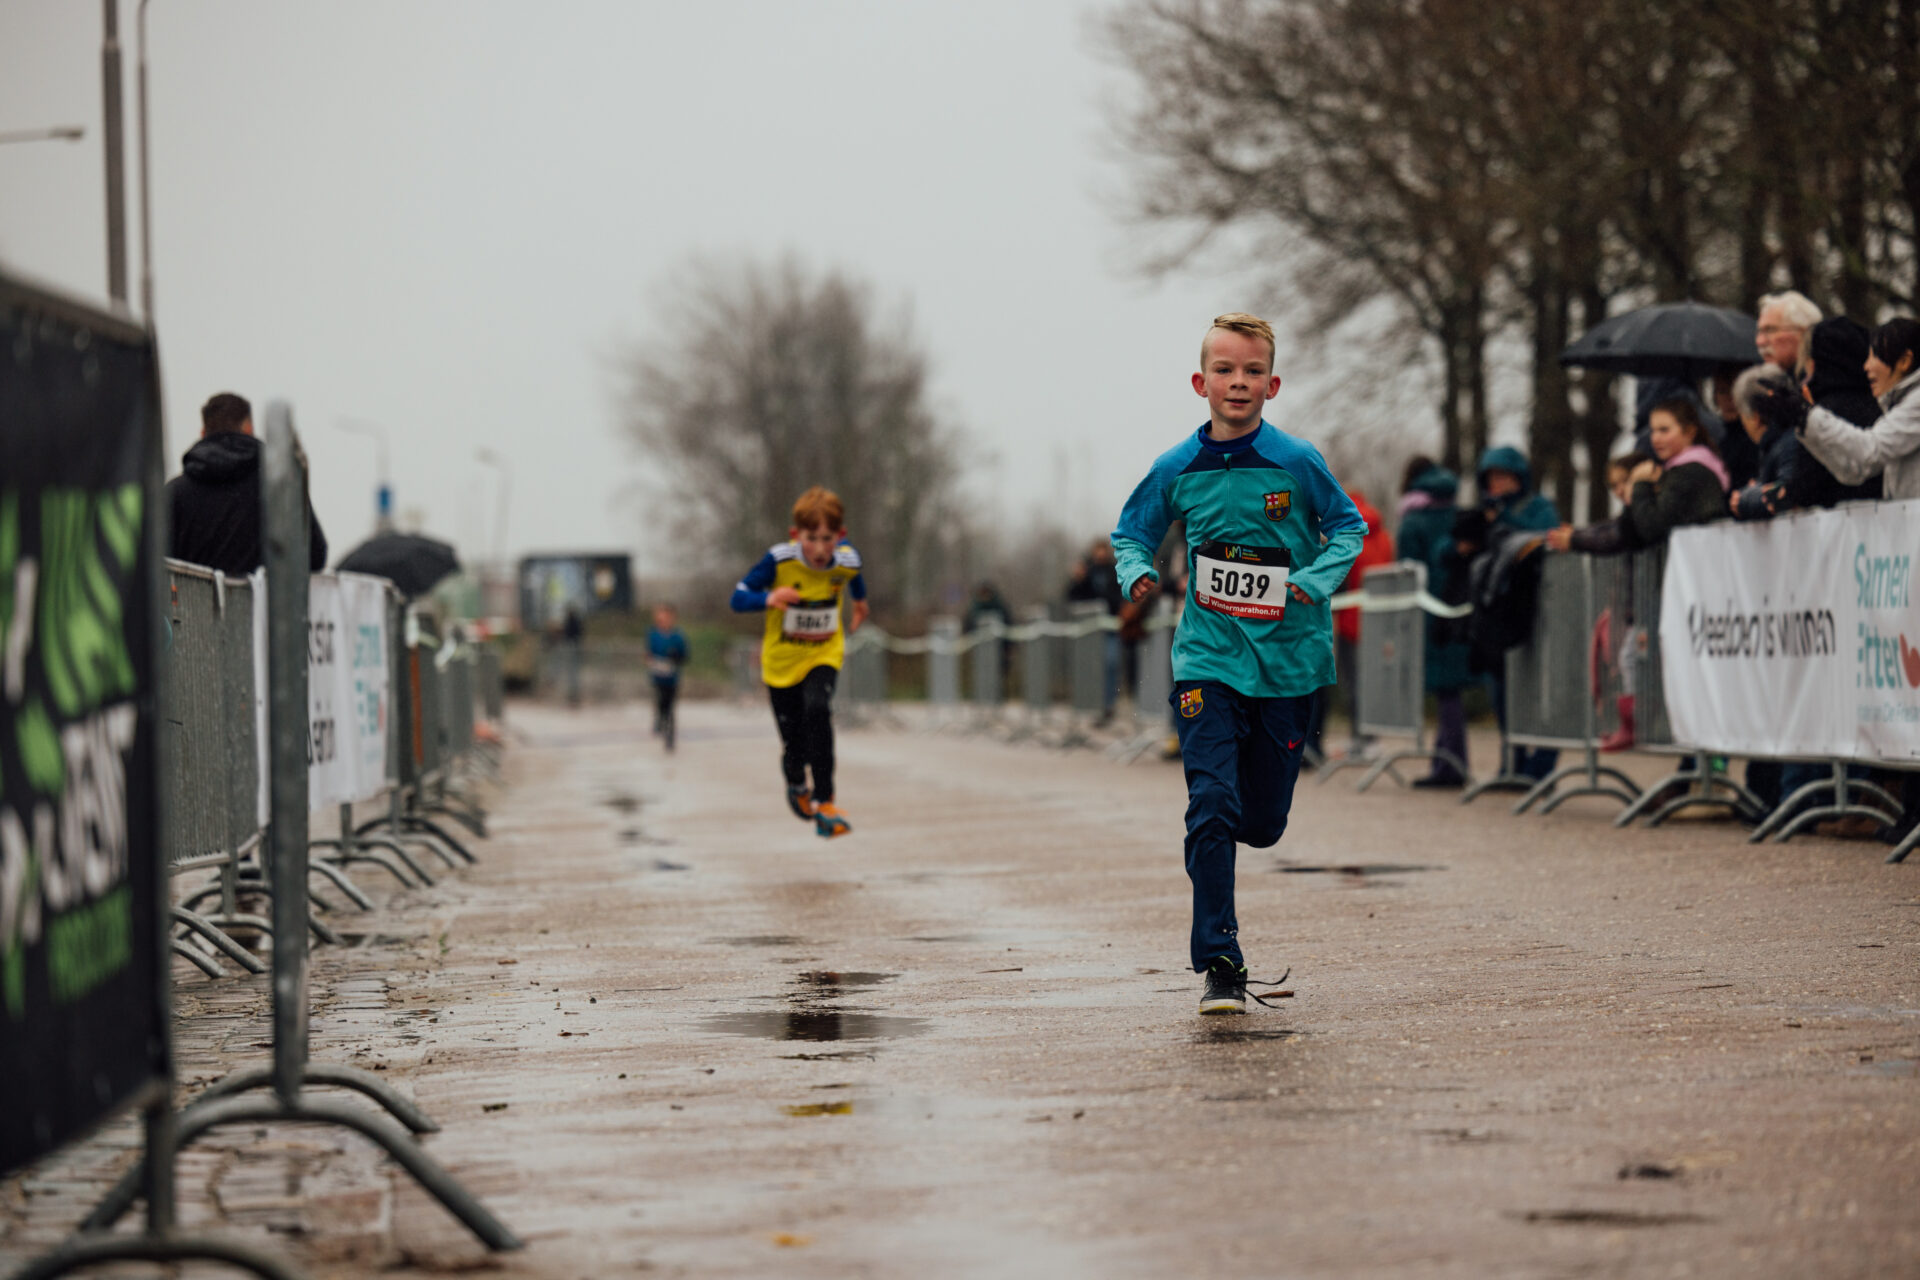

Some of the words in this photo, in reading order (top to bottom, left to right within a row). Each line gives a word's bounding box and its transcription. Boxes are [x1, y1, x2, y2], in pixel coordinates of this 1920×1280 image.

[1211, 568, 1270, 599] 5039
[1854, 542, 1910, 608] Samen
[1210, 599, 1280, 617] Wintermarathon.frl
[1763, 594, 1776, 658] is
